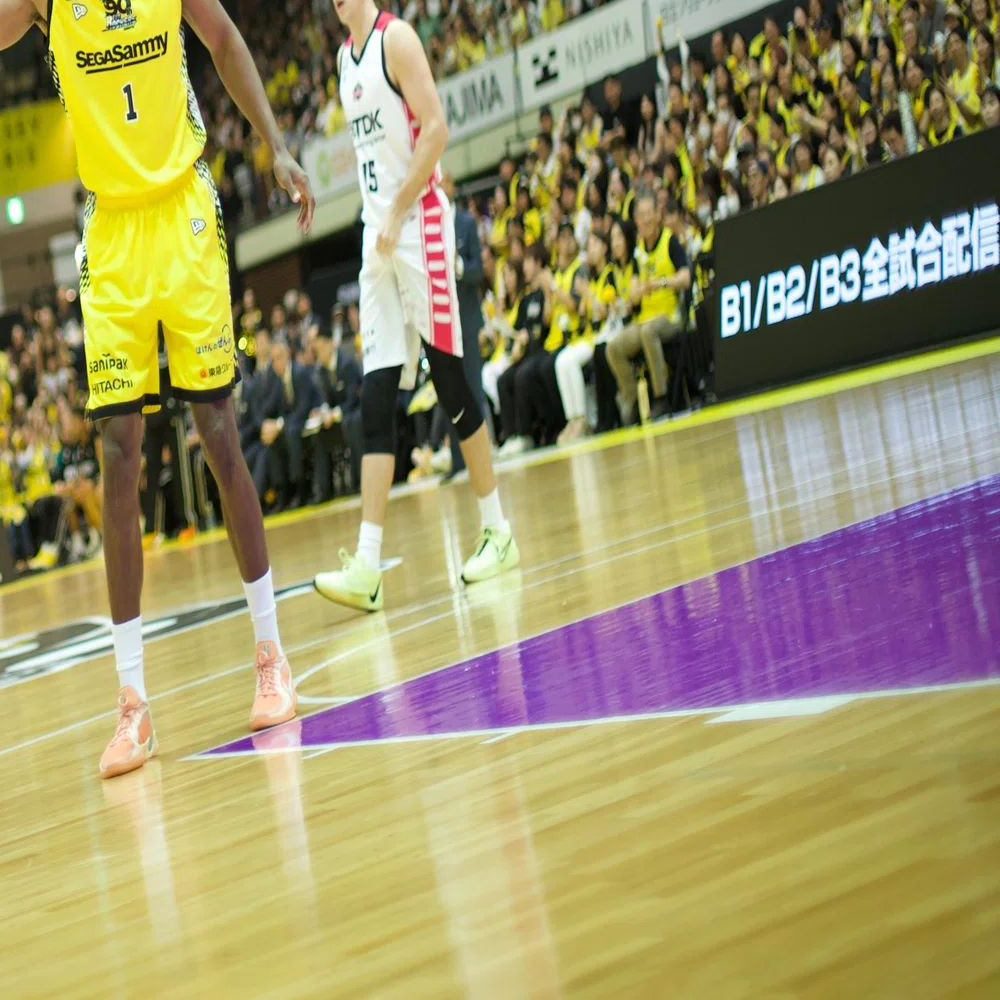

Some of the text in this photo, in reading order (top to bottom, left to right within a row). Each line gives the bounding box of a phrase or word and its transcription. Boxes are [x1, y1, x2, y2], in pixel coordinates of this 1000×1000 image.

[76, 31, 169, 68] SEGASammy
[122, 82, 138, 121] 1
[353, 108, 384, 137] TDK
[362, 160, 379, 193] 15
[92, 378, 133, 395] HITACHI
